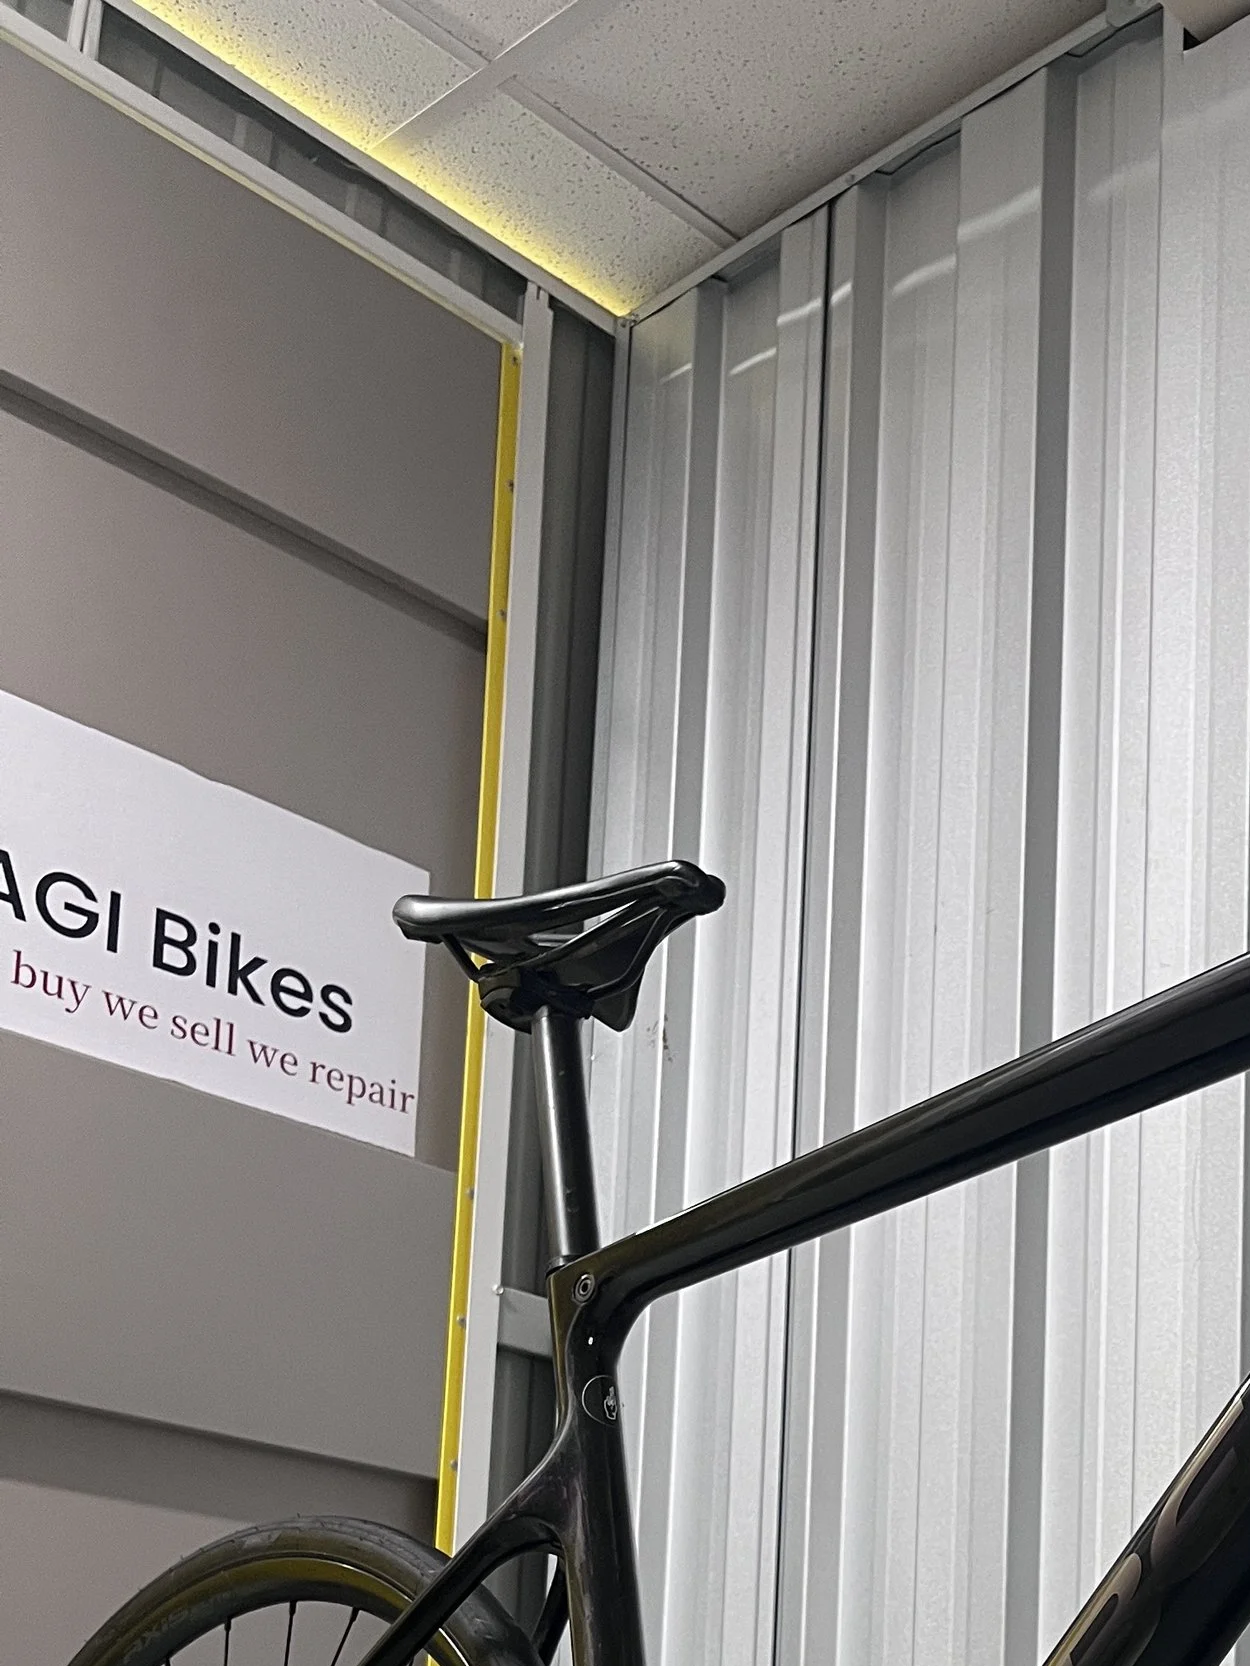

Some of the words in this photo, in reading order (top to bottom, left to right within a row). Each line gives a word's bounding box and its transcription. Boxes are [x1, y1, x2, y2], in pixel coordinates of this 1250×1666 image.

[10, 950, 91, 1014] buy
[101, 988, 160, 1030] we
[170, 1009, 237, 1057] sell
[247, 1038, 298, 1077] we
[309, 1059, 415, 1115] repair
[152, 907, 354, 1034] Bikes
